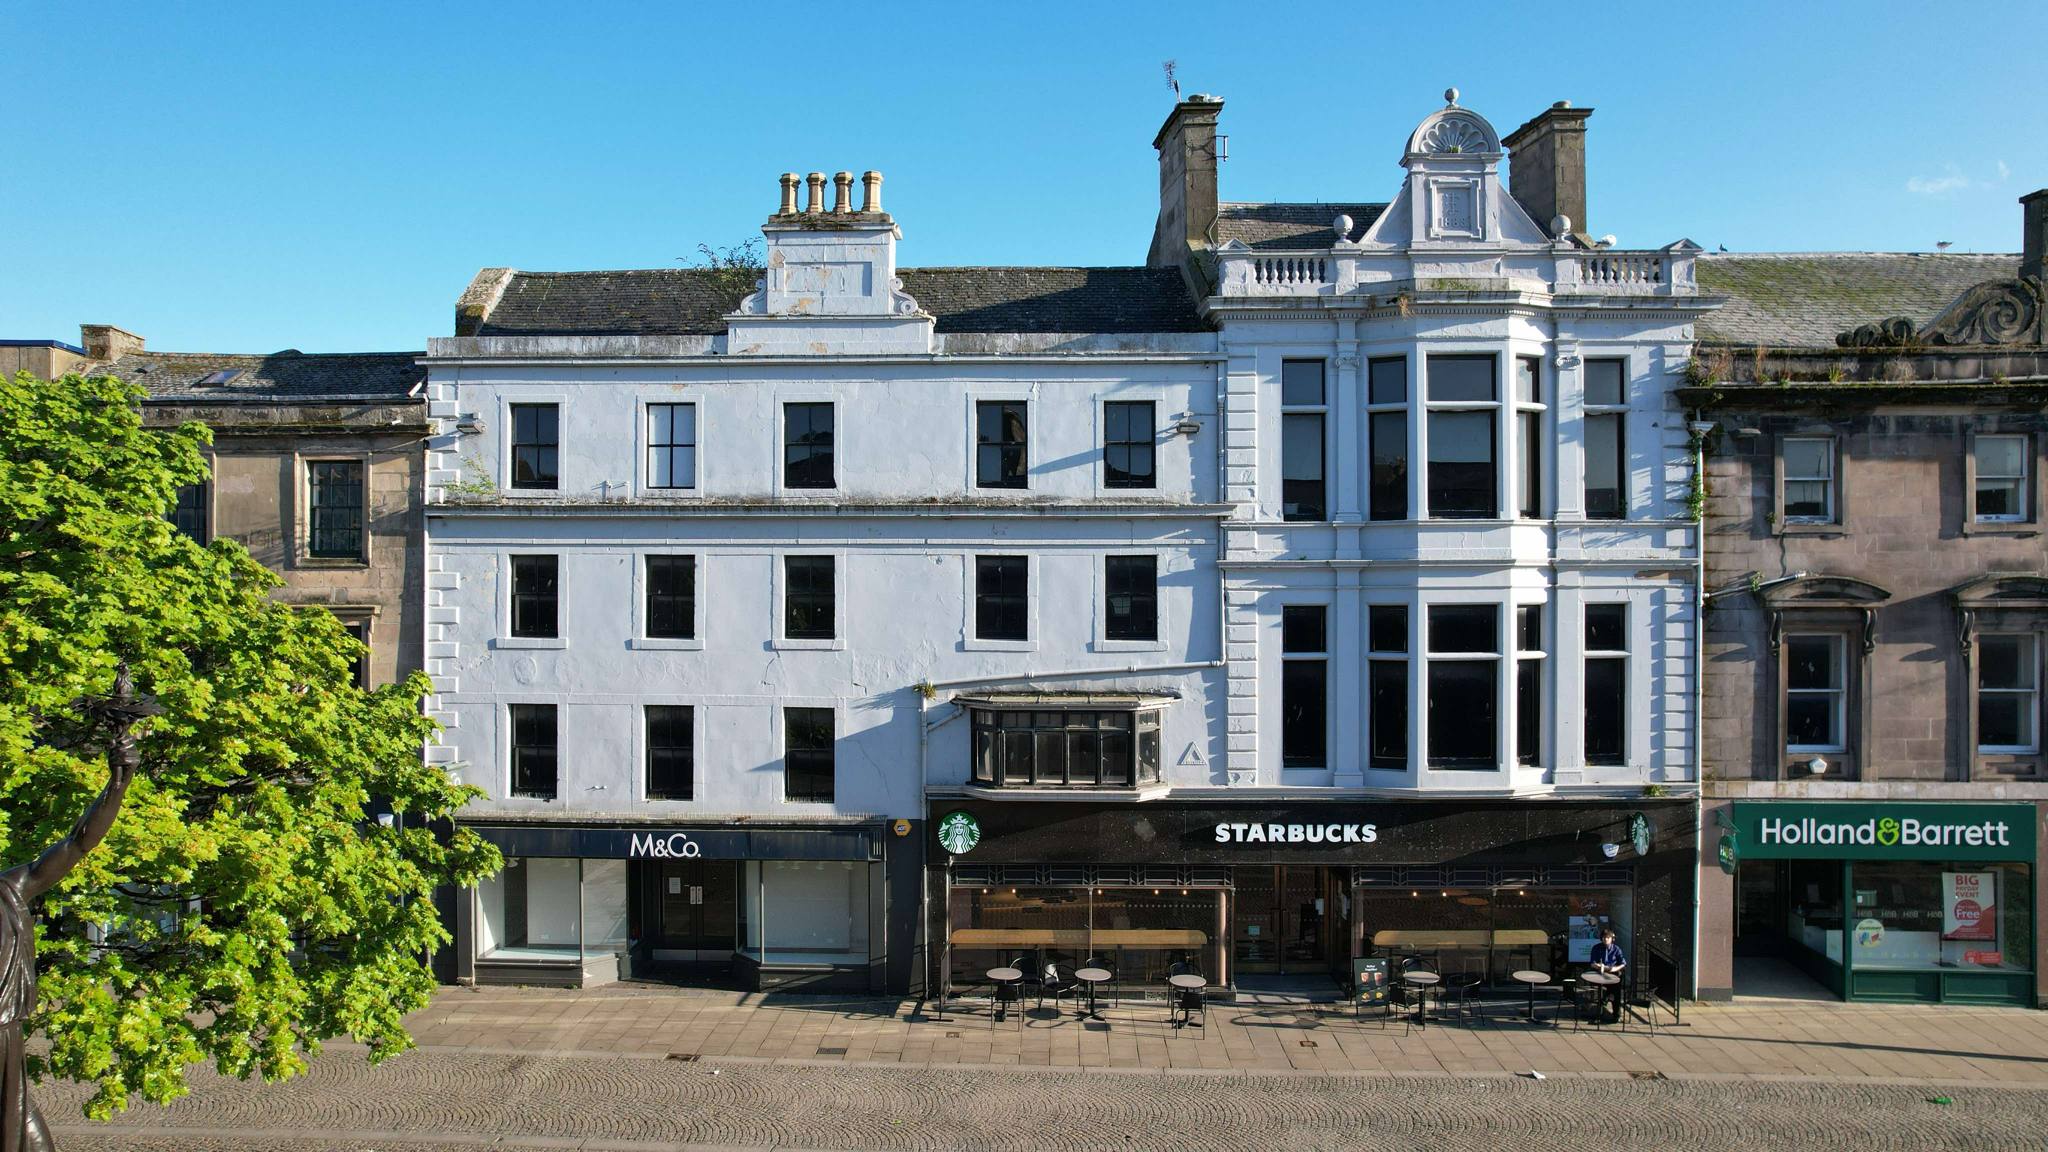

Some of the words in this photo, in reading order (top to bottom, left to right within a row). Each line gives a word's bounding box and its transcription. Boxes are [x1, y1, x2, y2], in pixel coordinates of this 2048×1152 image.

[1215, 823, 1378, 843] STARBUCKS
[1955, 874, 1979, 886] BIG
[1956, 908, 1980, 919] Free
